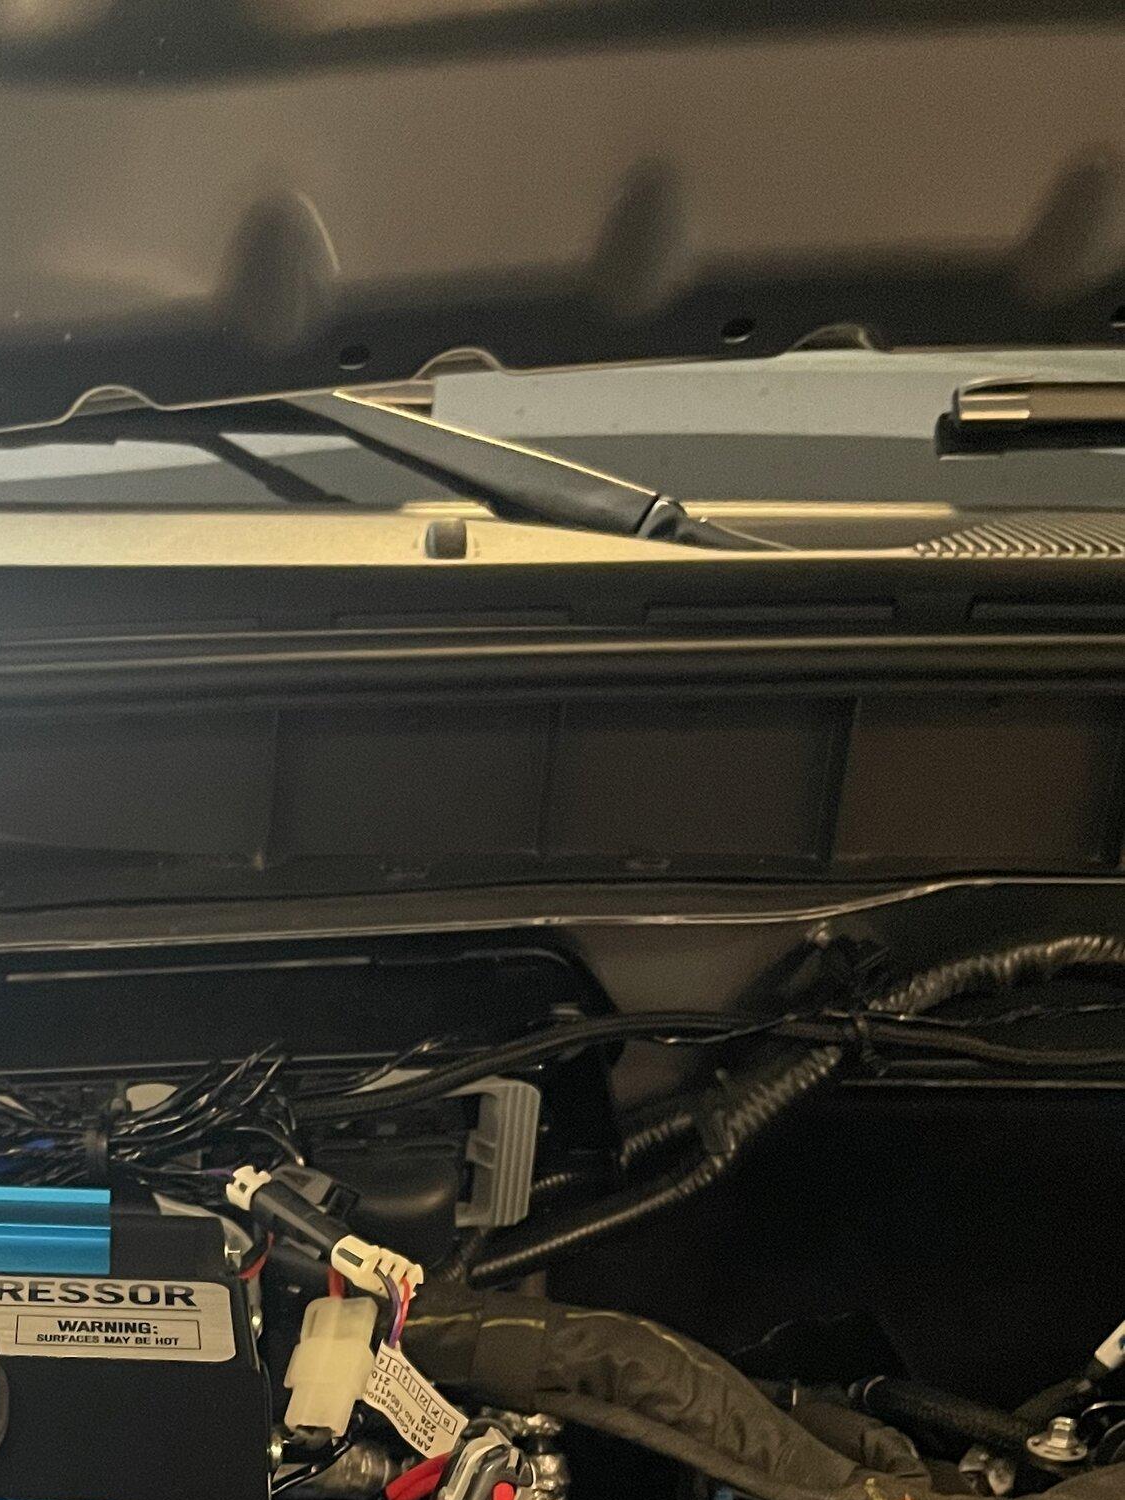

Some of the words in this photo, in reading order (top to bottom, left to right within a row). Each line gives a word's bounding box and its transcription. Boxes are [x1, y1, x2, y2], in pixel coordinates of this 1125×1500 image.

[57, 1319, 158, 1335] WARNING:
[36, 1334, 100, 1345] SURFACES
[104, 1335, 131, 1345] MAY
[135, 1336, 152, 1346] BE
[155, 1337, 180, 1347] HOT
